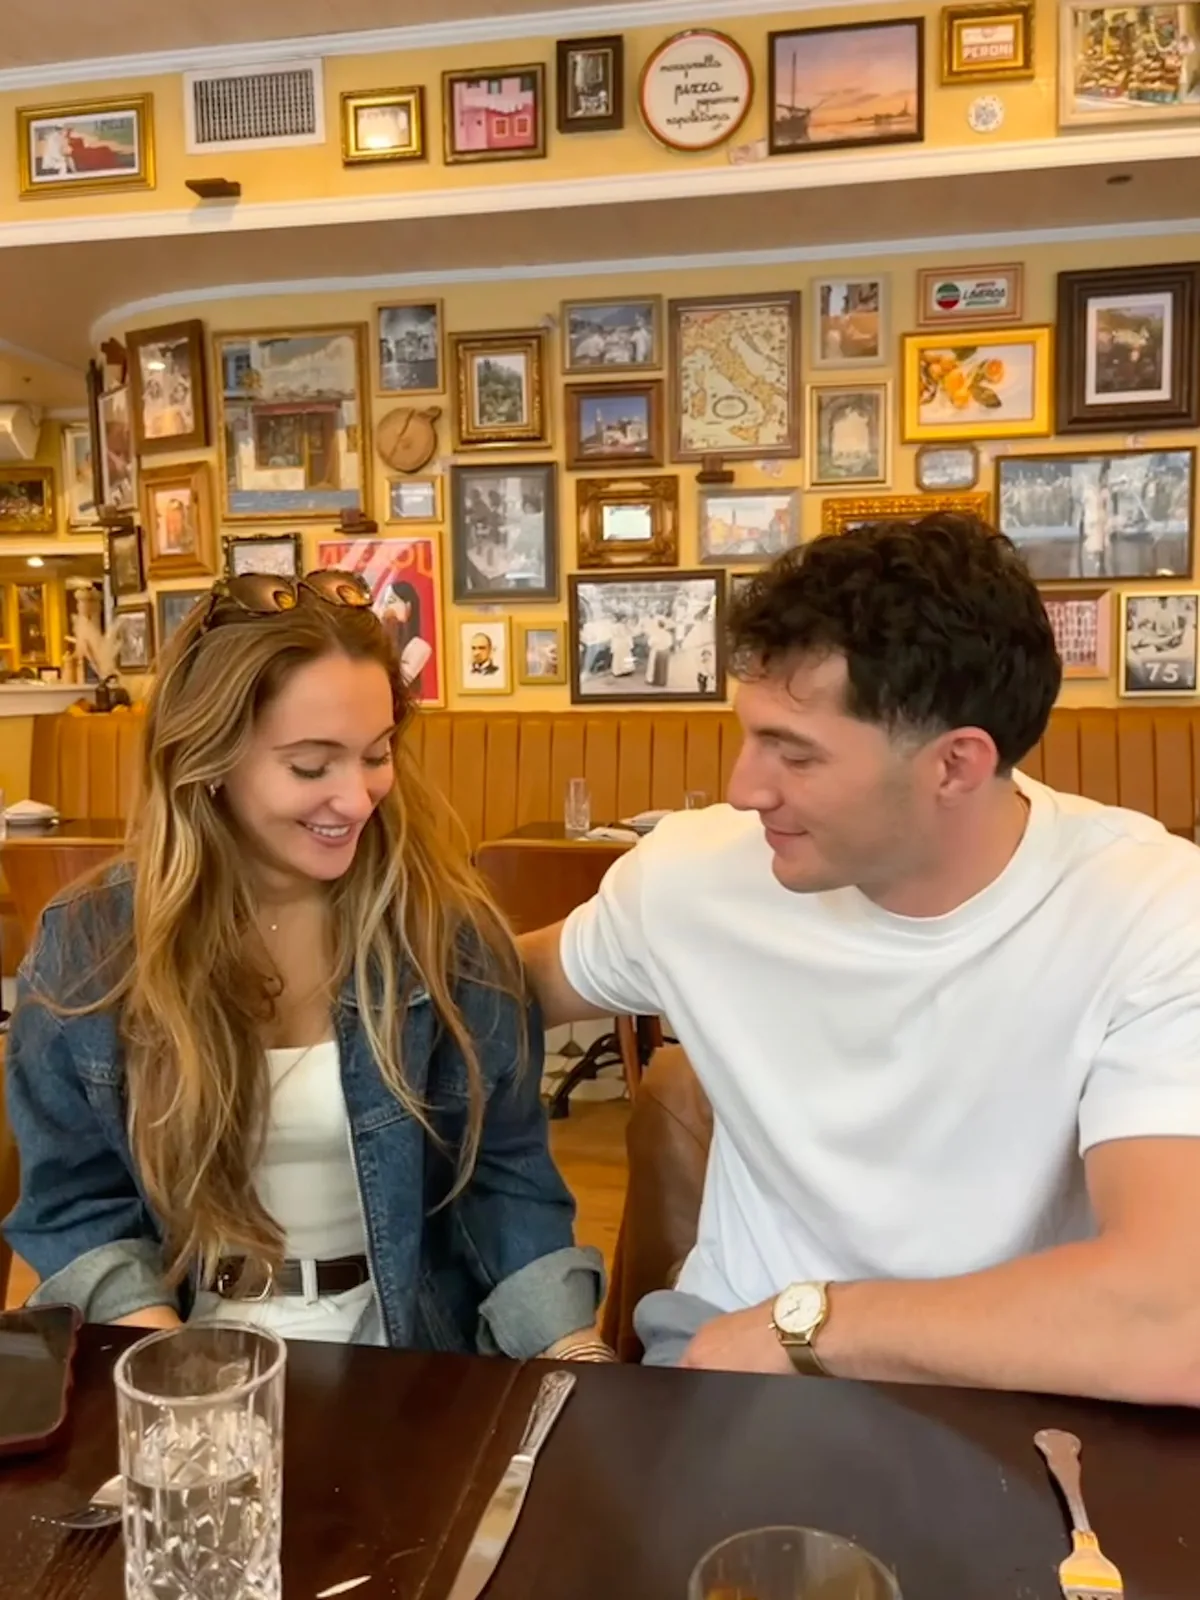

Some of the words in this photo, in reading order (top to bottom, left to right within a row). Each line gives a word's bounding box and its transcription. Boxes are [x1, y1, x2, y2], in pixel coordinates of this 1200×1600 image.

[963, 43, 1014, 59] PERONI
[674, 82, 723, 105] pizza
[1146, 663, 1179, 683] 75
